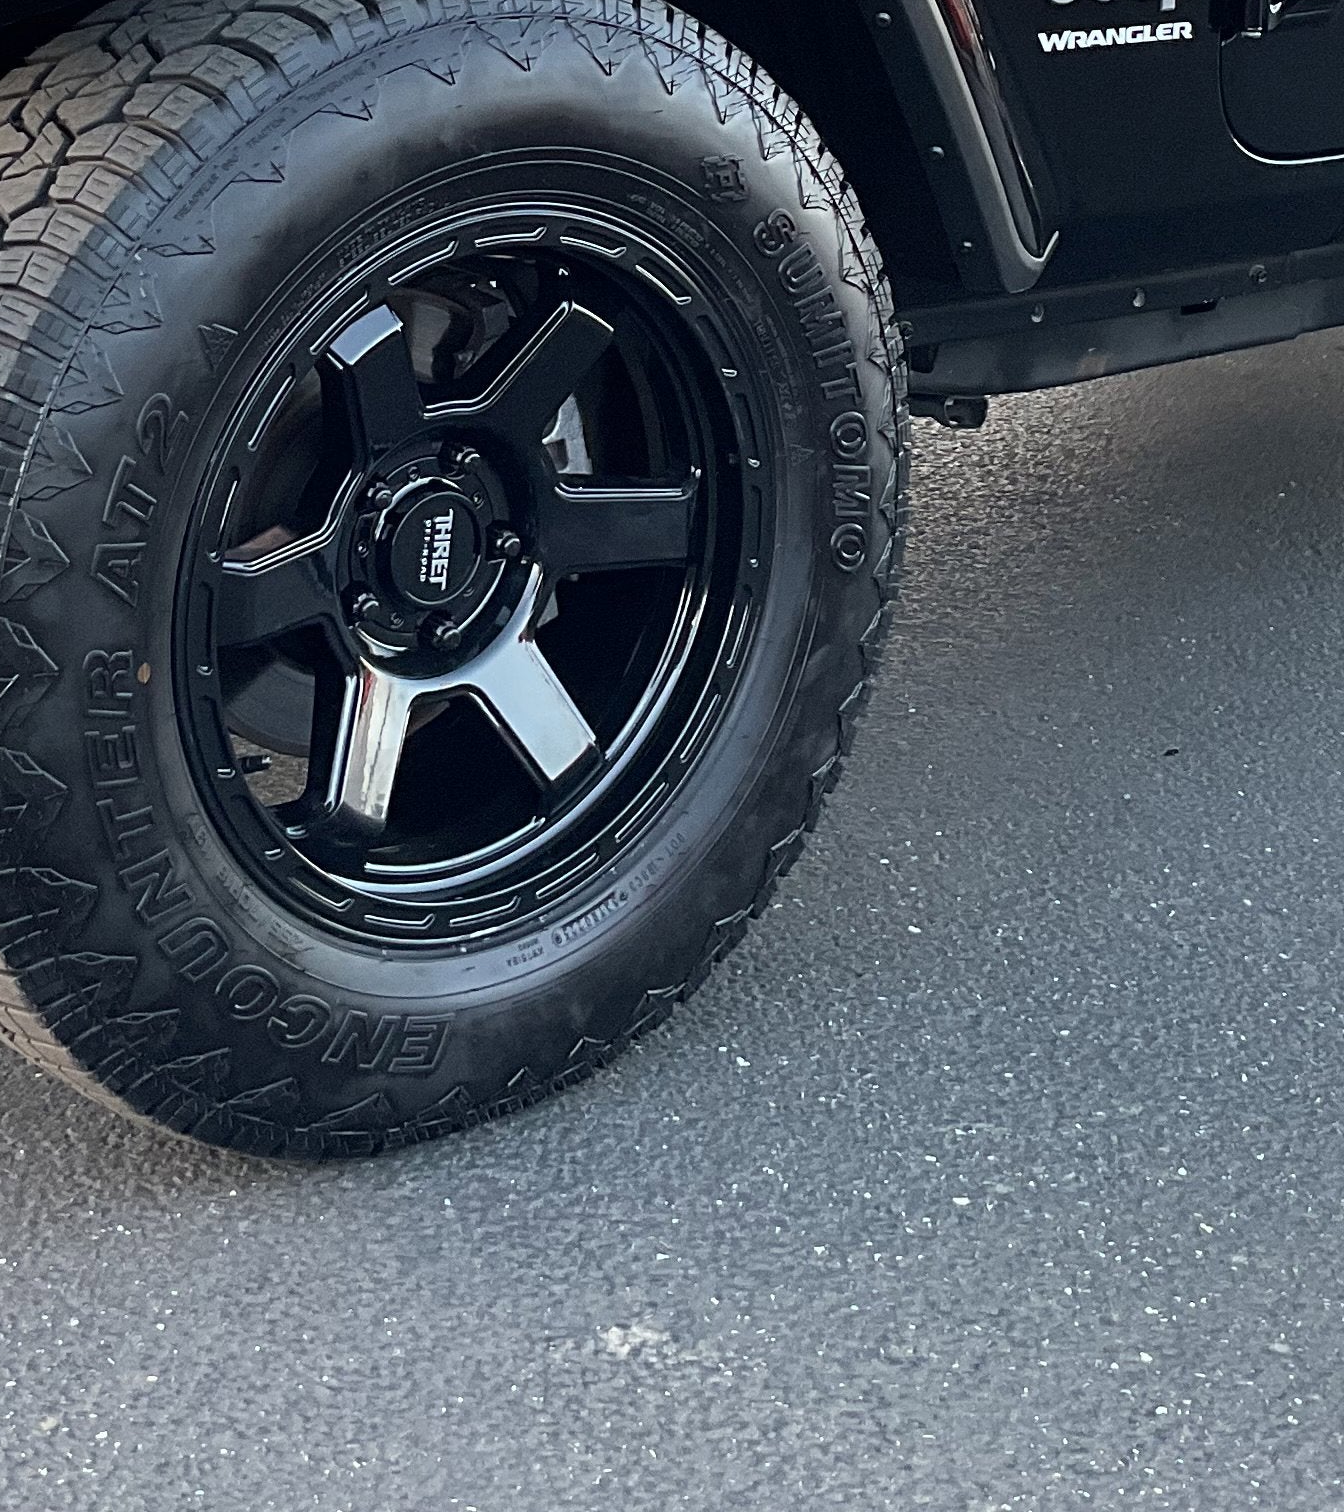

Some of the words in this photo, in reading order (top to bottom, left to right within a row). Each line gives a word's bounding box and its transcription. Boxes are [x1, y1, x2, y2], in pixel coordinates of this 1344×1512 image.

[1038, 21, 1193, 52] WRANGLER
[428, 508, 454, 591] THRET
[82, 647, 457, 1077] ENCOUNTER
